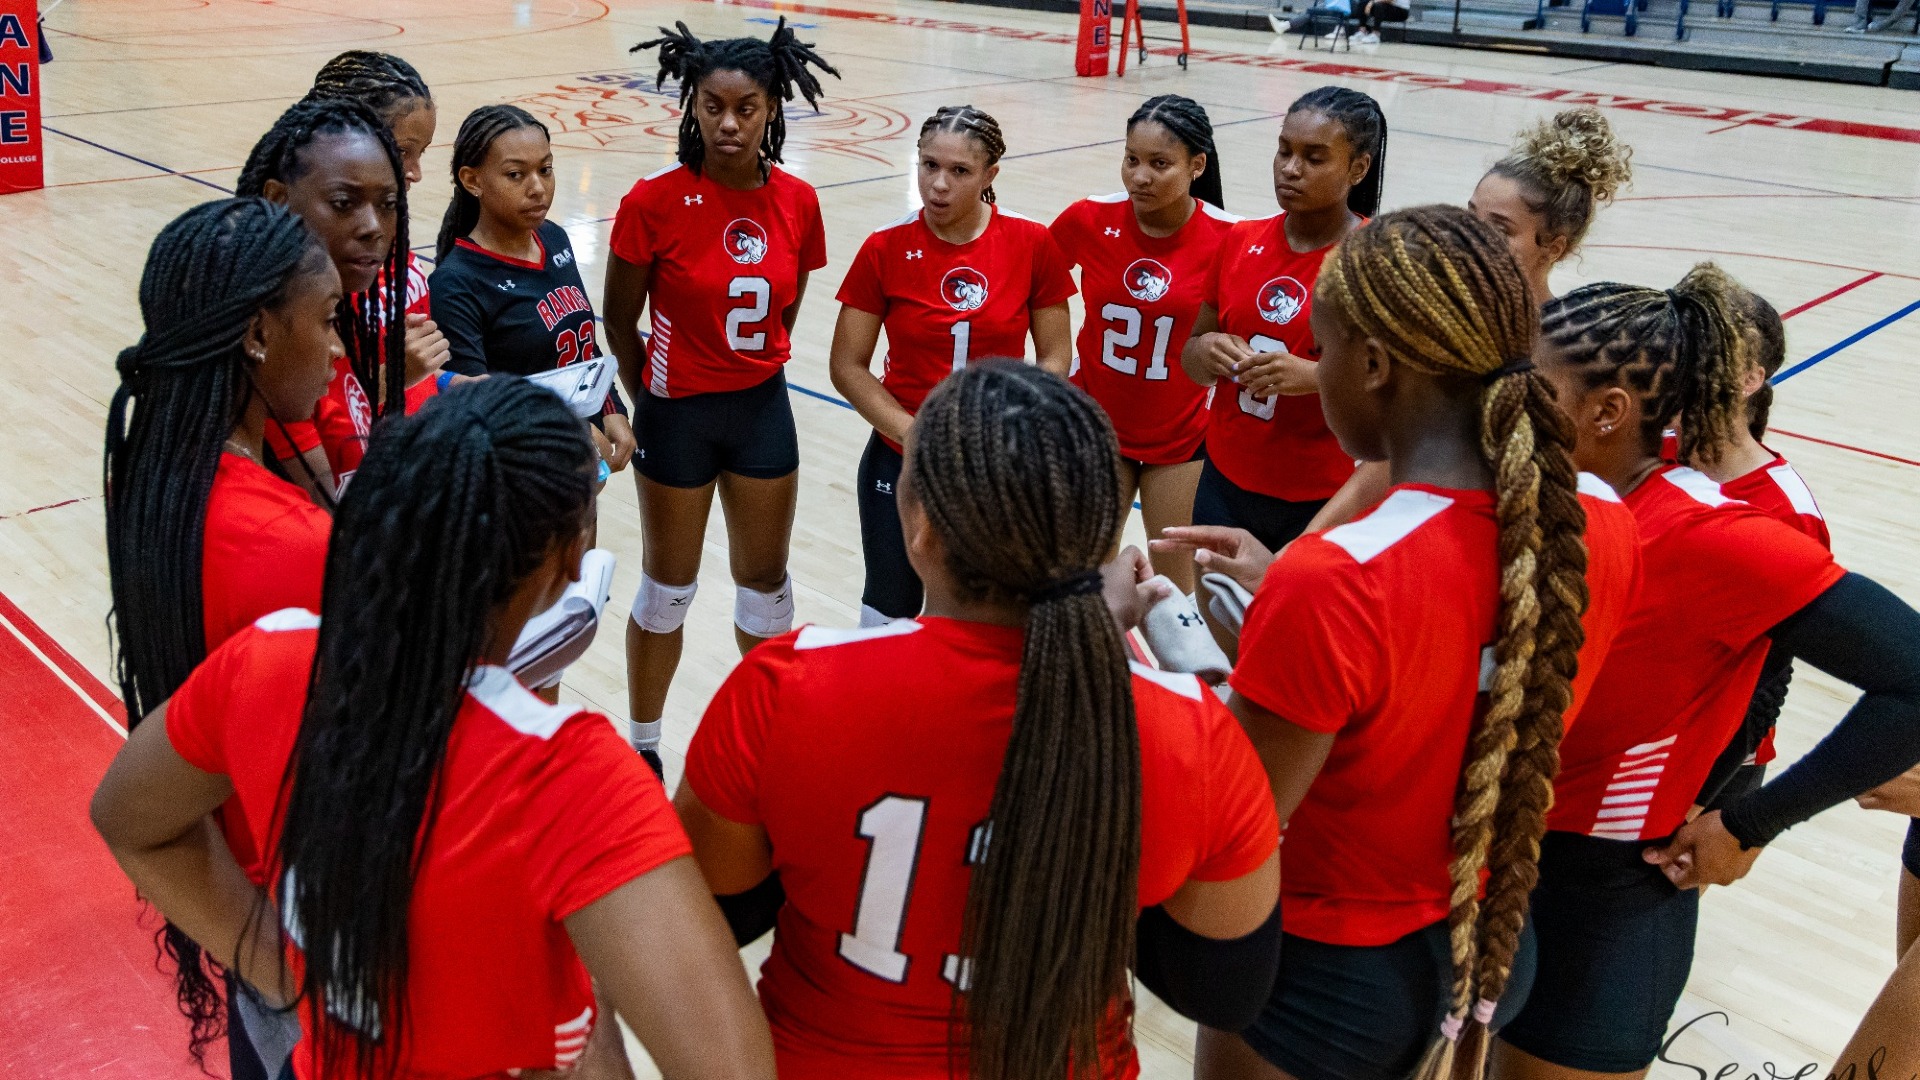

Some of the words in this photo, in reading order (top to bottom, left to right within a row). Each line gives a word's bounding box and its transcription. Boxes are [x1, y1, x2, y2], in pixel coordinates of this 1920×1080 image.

[536, 286, 590, 331] RAMS
[725, 275, 771, 352] 2
[950, 320, 970, 373] 1
[1101, 302, 1174, 381] 21
